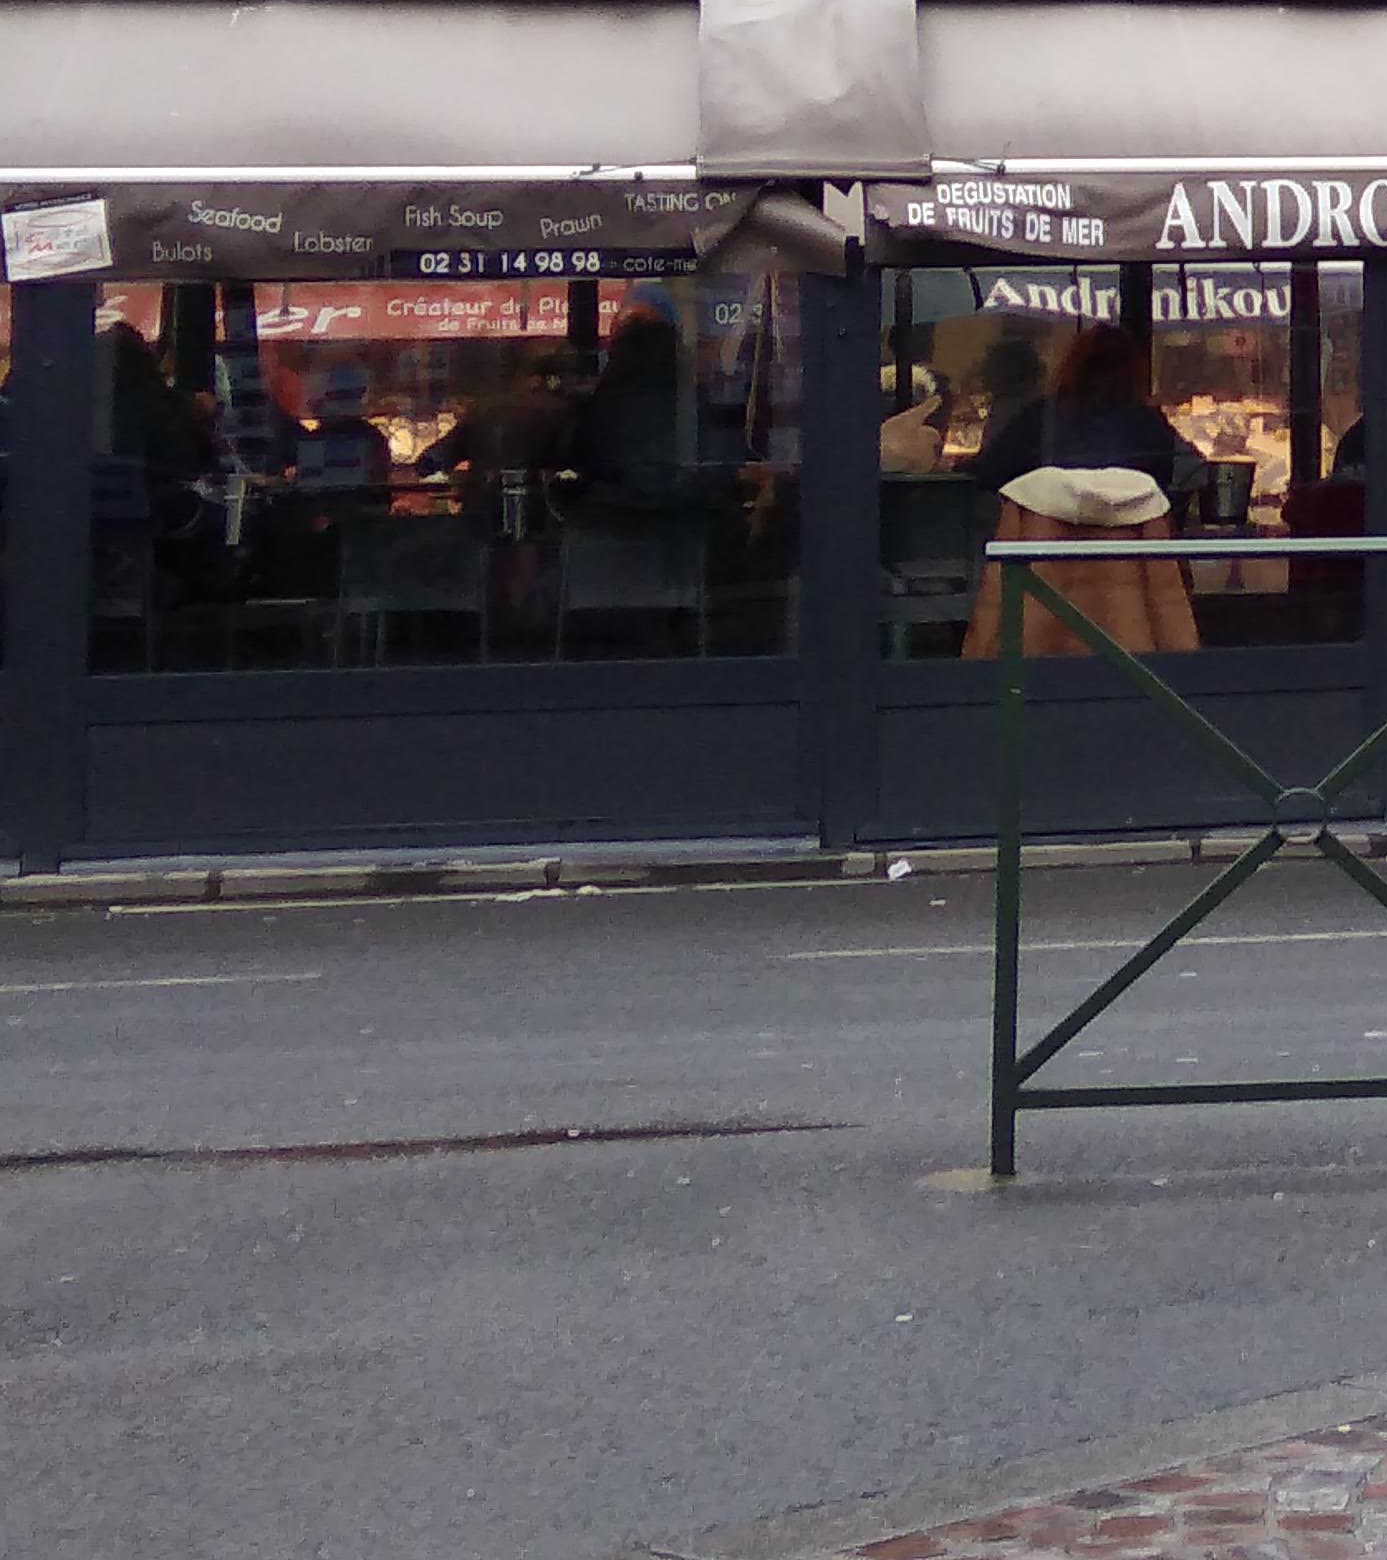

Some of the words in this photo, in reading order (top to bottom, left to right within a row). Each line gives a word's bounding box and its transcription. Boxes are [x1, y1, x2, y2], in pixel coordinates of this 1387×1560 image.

[624, 191, 700, 213] TASTING
[936, 181, 1073, 209] DEGUSTATION
[188, 200, 284, 234] Seafood
[405, 205, 442, 228] Fish
[449, 205, 504, 231] Soup
[540, 213, 603, 240] Prawn
[907, 202, 936, 226] DE
[946, 206, 1014, 239] FRUITS
[1025, 211, 1052, 243] DE
[1062, 217, 1105, 246] MER
[153, 241, 213, 263] Bulots
[294, 230, 374, 253] Lobster
[420, 251, 450, 274] 02
[457, 251, 486, 274] 31
[501, 251, 528, 274] 14
[535, 250, 565, 274] 98
[571, 250, 601, 274] 98
[387, 296, 493, 316] Créateur
[983, 276, 1293, 321] Andrnikou
[712, 302, 745, 325] 02
